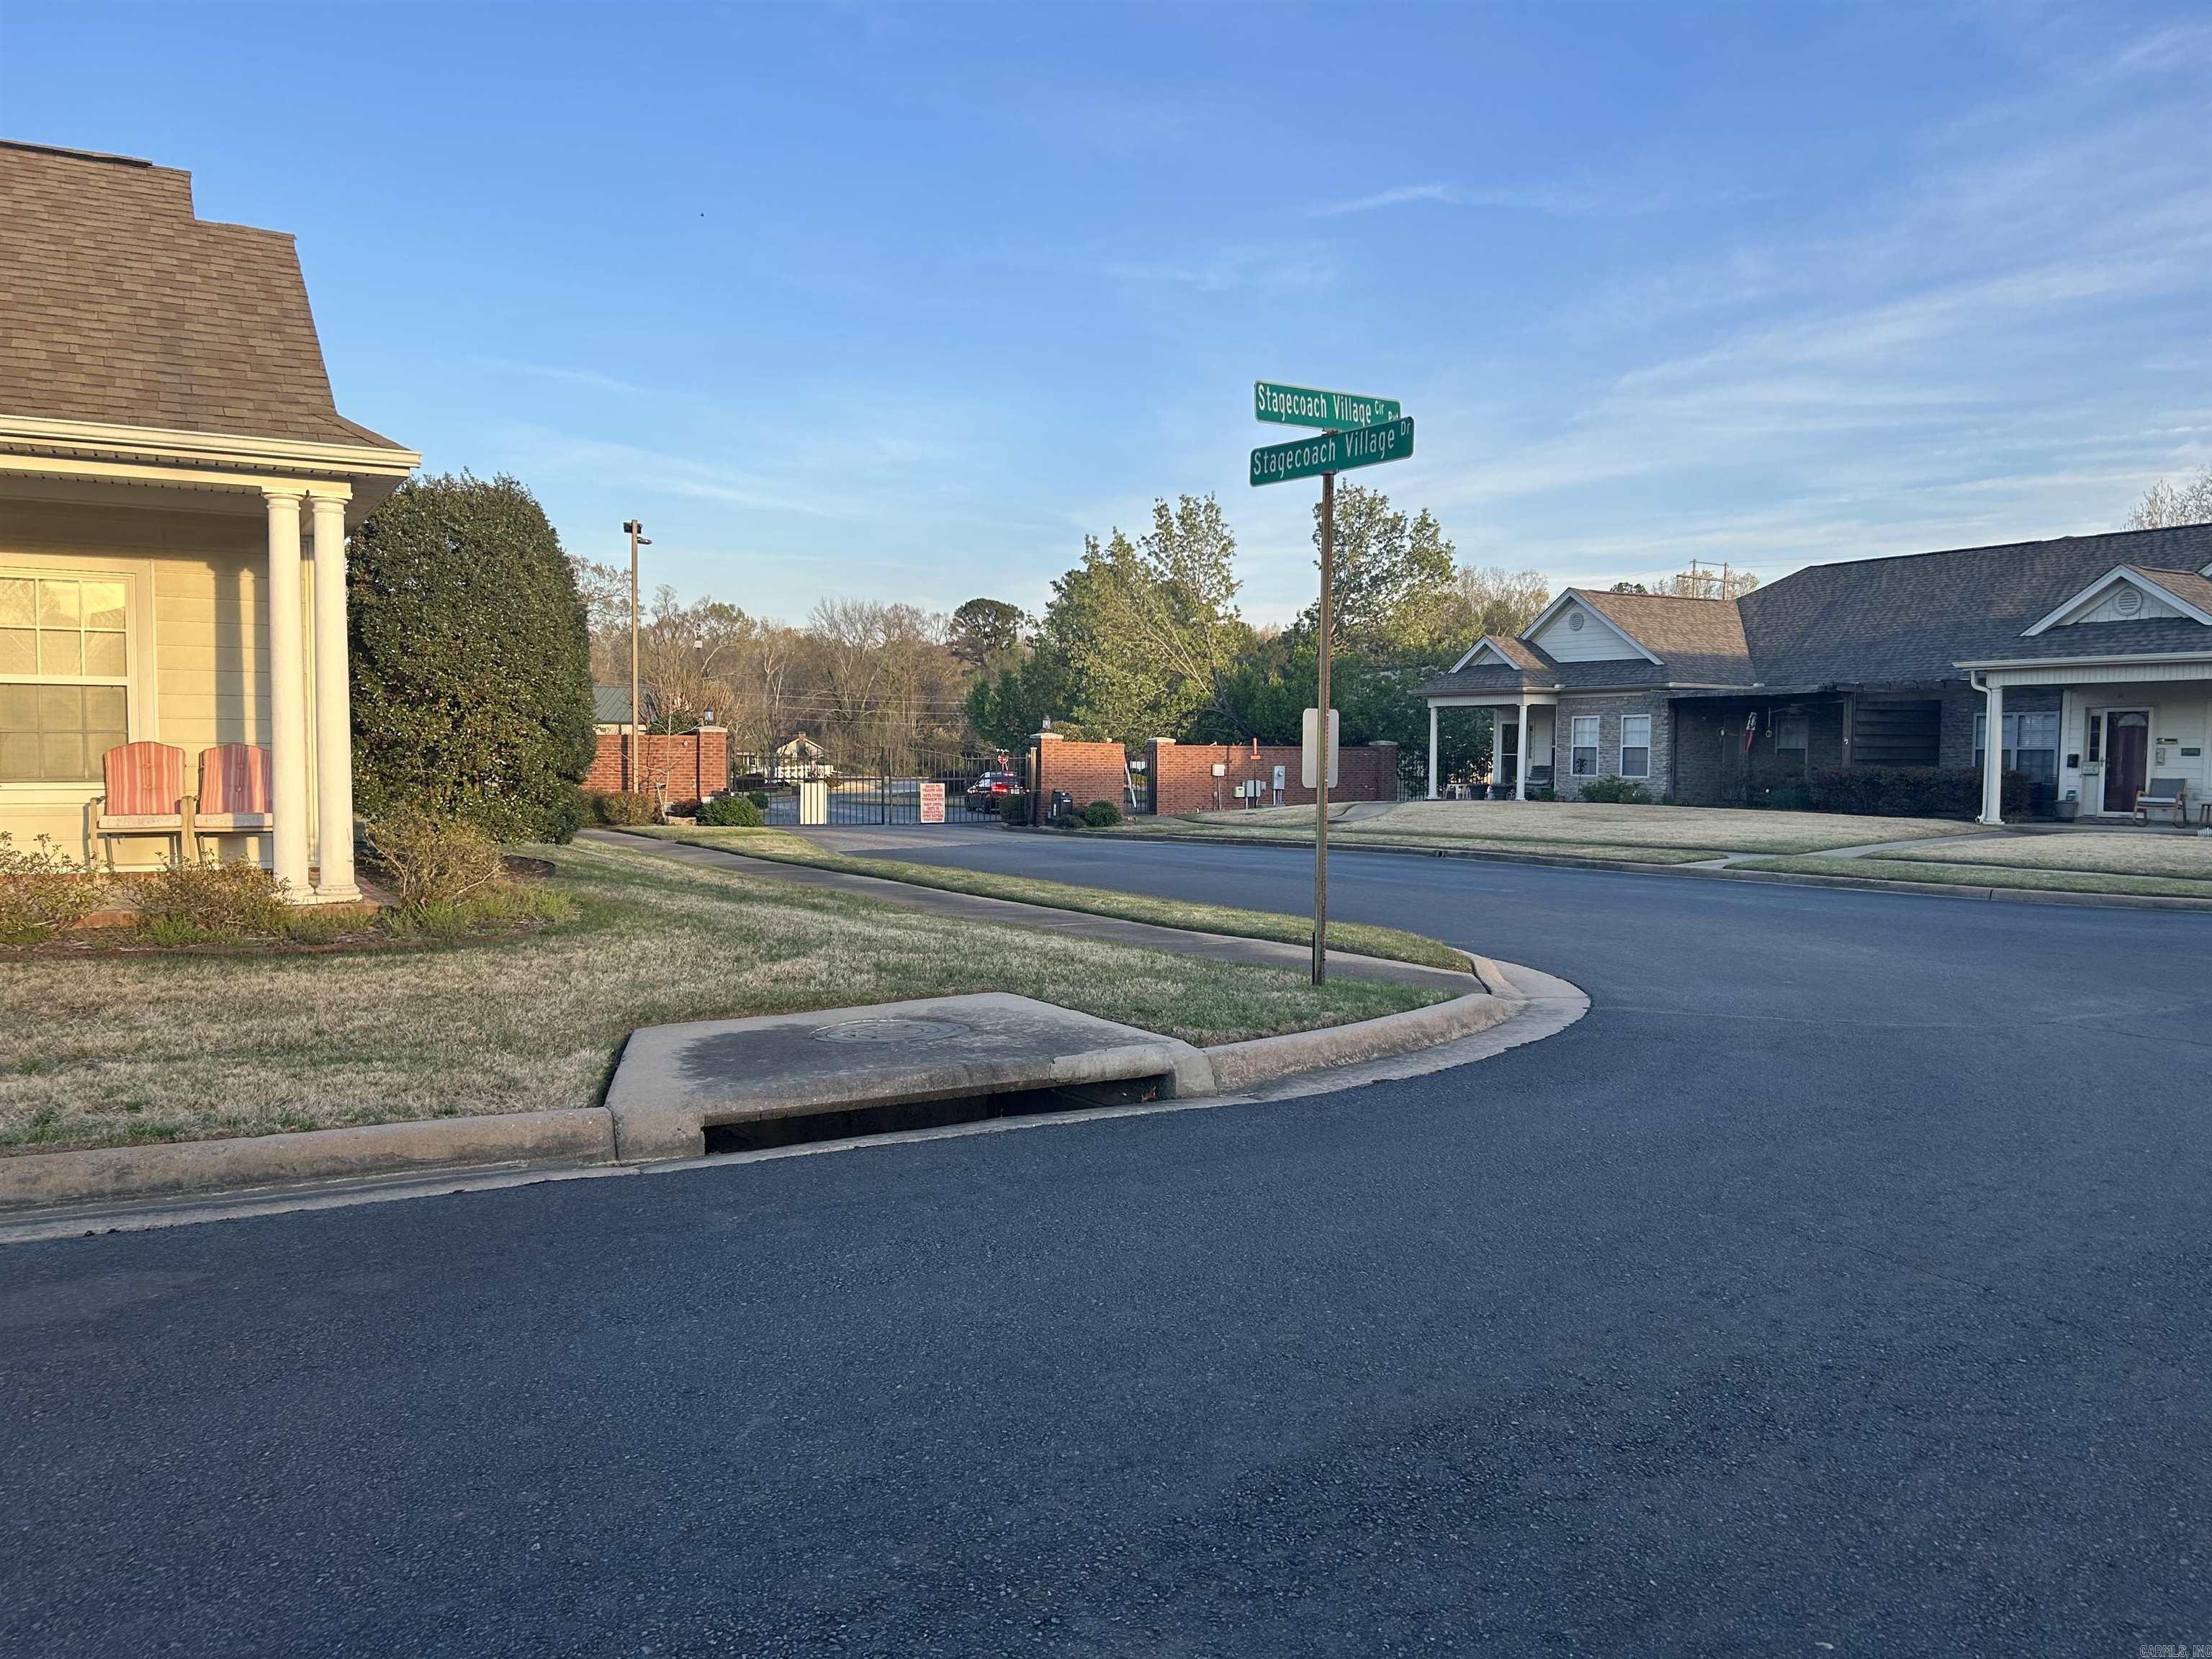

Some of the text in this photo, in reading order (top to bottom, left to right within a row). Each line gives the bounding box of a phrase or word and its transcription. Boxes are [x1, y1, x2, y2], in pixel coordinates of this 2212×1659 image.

[1258, 385, 1385, 426] Stagecoach Village Cir
[1254, 421, 1411, 478] Stagecoach Village Dr
